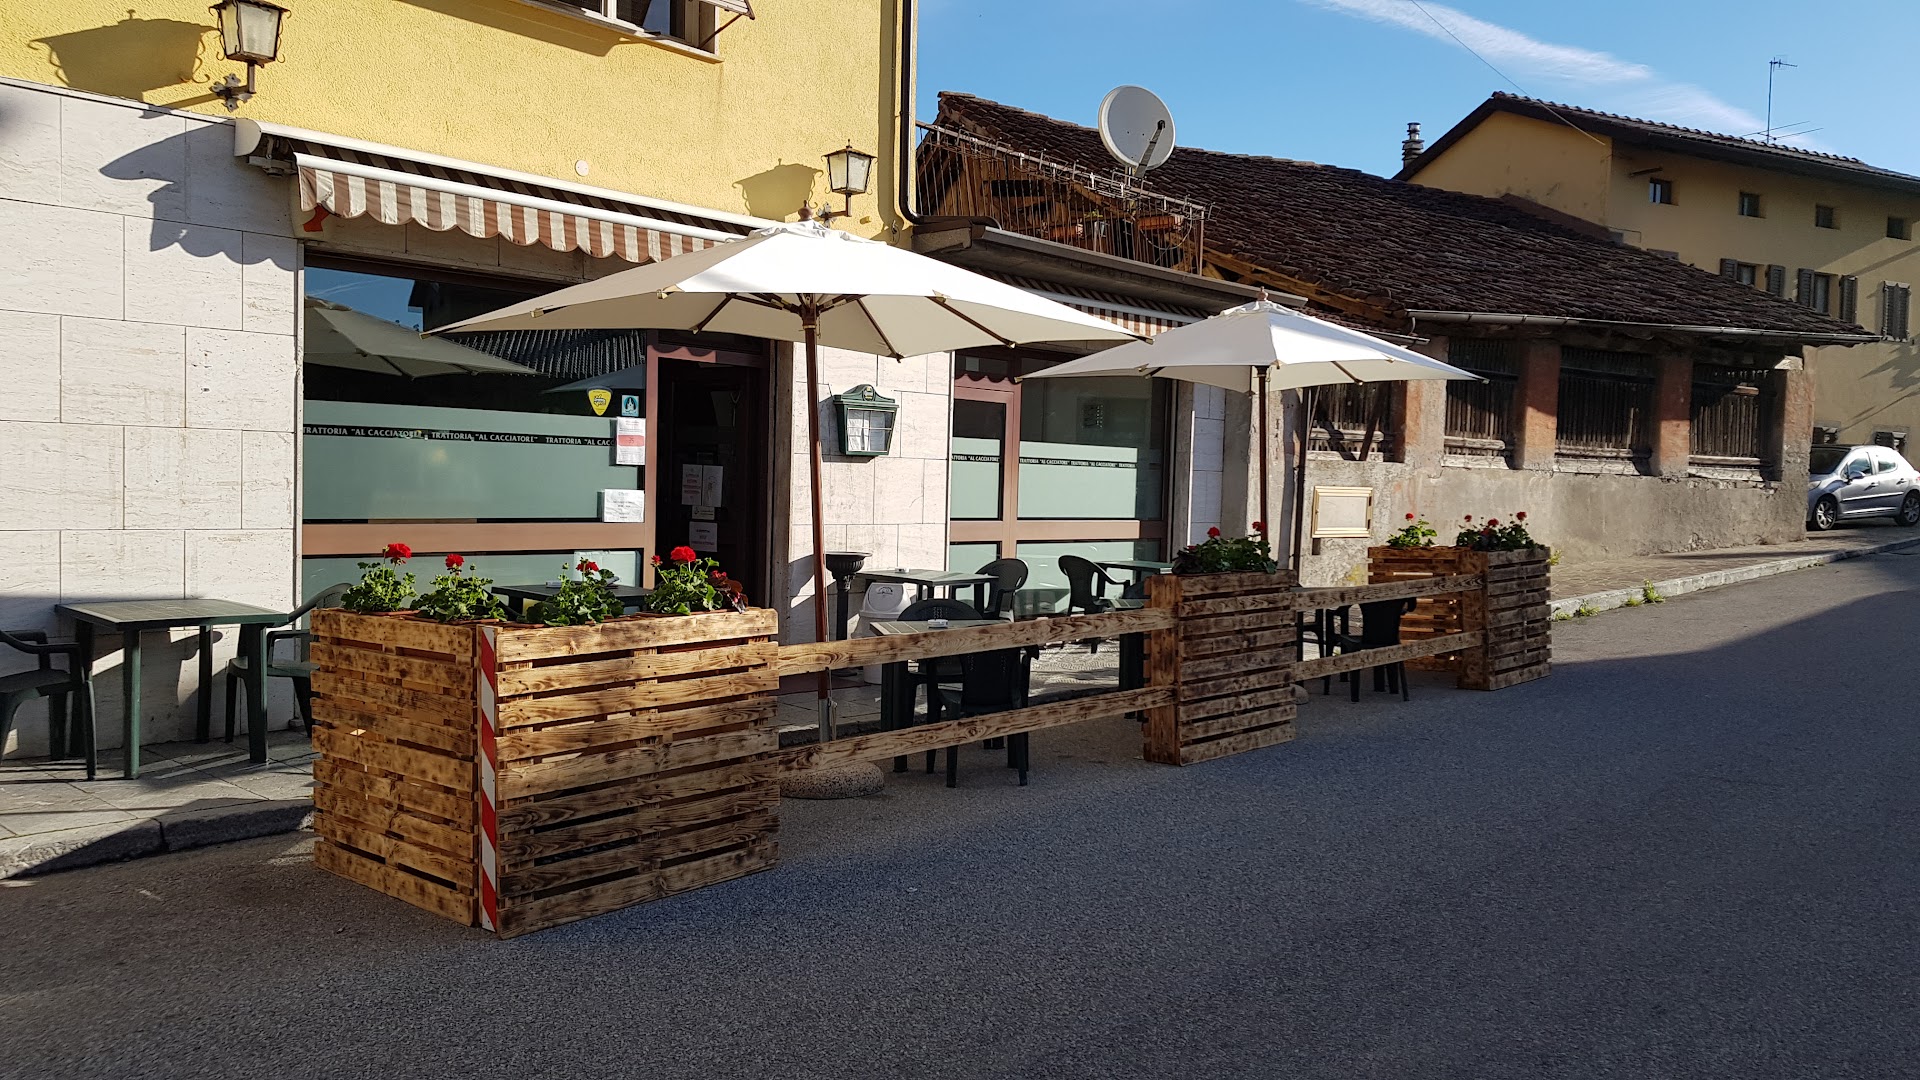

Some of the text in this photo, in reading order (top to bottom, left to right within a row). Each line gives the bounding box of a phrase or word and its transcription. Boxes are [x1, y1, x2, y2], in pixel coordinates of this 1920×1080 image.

[303, 426, 348, 435] TRATTORIA
[351, 428, 366, 436] "AL
[432, 431, 472, 440] TRATTORIA
[475, 433, 488, 441] "AL
[546, 436, 582, 445] TRATTORIA
